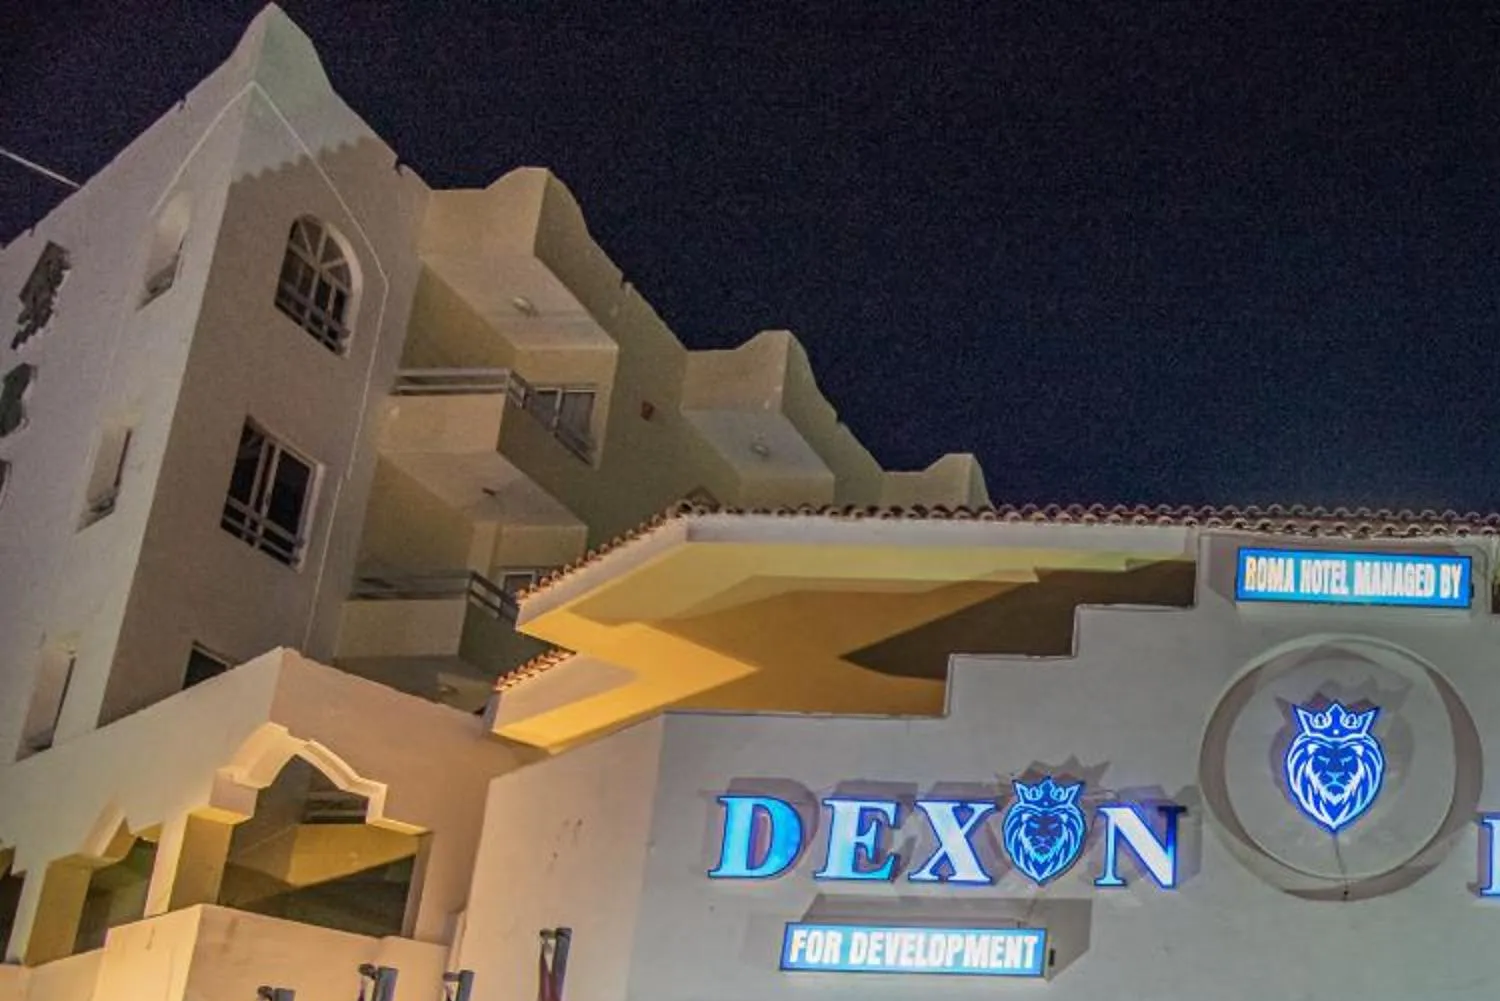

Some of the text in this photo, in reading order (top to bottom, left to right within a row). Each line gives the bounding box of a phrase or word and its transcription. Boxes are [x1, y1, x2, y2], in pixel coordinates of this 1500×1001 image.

[1244, 556, 1462, 599] ROMA HOTEL MANAGED BY
[790, 929, 1039, 969] FOR DEVELOPMENT
